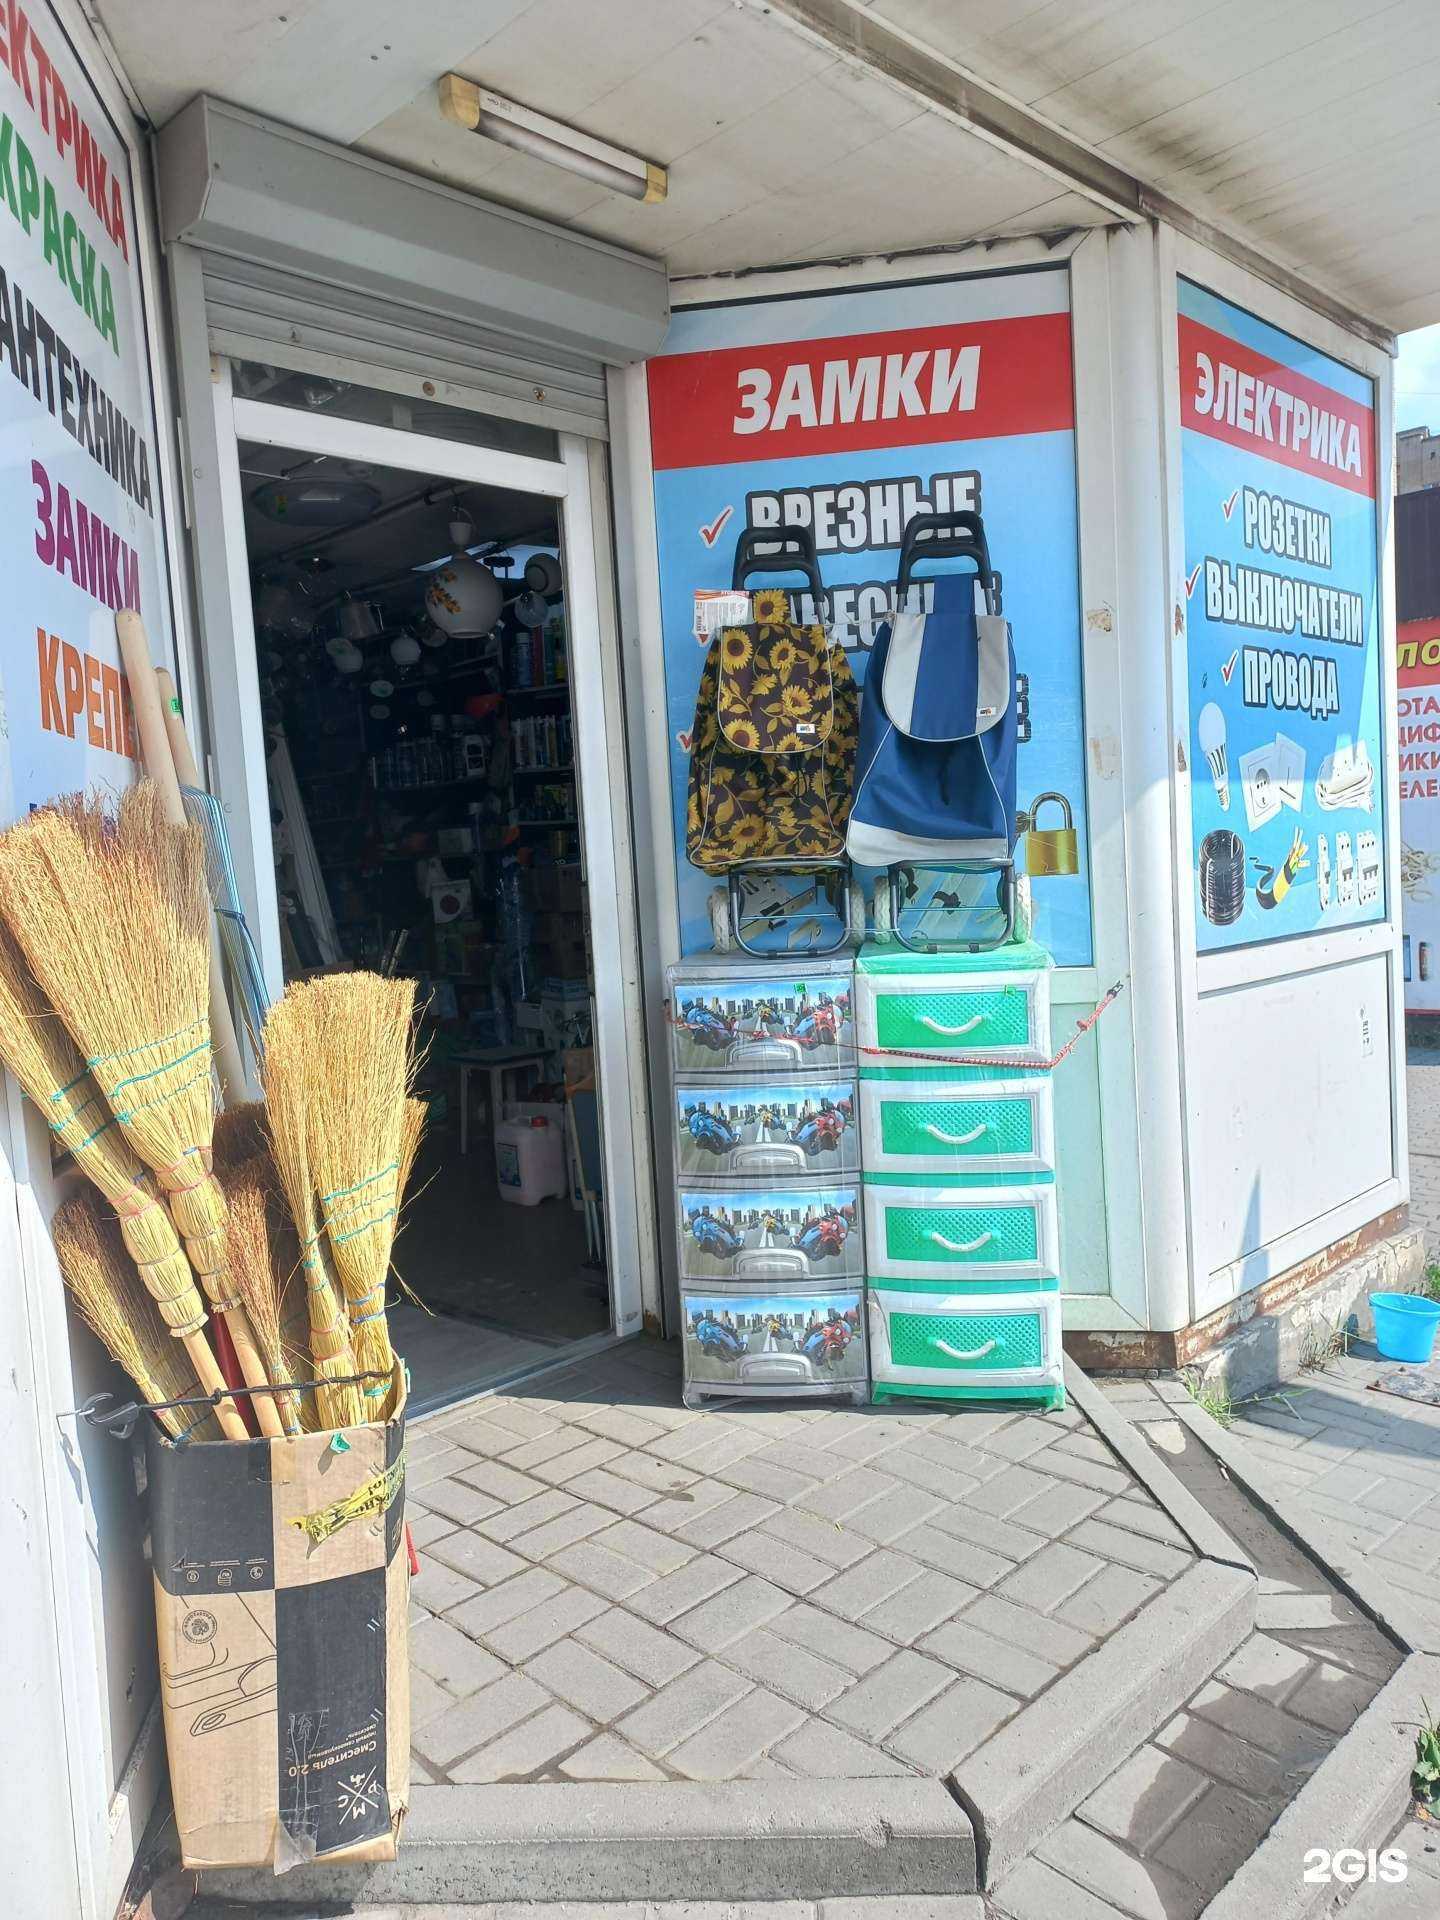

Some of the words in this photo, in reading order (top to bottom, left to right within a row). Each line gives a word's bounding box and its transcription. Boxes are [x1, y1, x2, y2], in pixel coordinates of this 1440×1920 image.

[732, 345, 981, 435] ЗАМКИ
[1194, 352, 1362, 477] ЭЛЕКТРИКА
[32, 459, 141, 616] ЗАМКИ
[749, 473, 978, 557] ВРЕЗНЫЕ
[1244, 488, 1331, 567] РОЗЕТКИ
[1205, 557, 1363, 645] ВЫКЛЮЧАТЕЛИ
[1243, 646, 1339, 719] ПРОВОДА
[1400, 780, 1440, 799] ЕЛЕ
[313, 1741, 376, 1769] Смеситель
